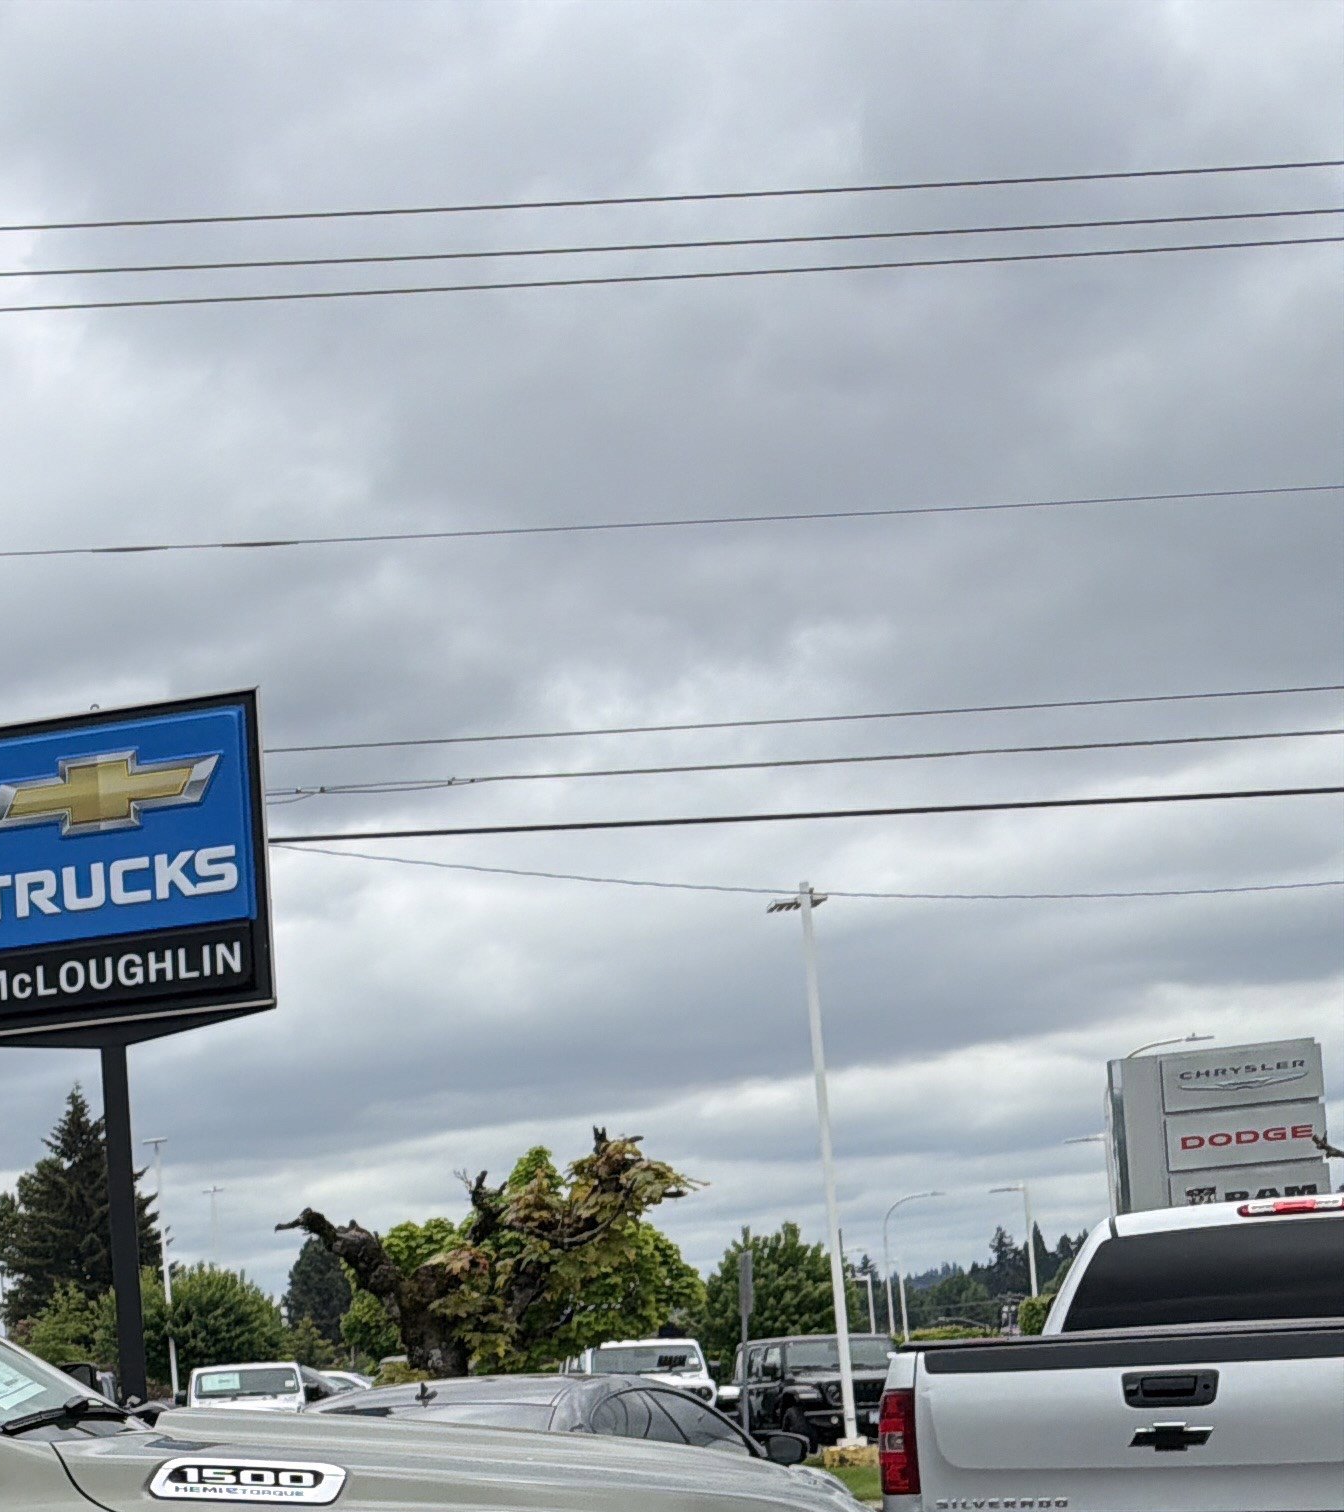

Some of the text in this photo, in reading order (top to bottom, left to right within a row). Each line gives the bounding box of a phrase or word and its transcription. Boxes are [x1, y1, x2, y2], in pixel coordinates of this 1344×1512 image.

[1179, 1059, 1305, 1081] CHRYSLER
[1180, 1124, 1313, 1151] DODGE
[182, 1466, 315, 1488] 1500
[174, 1485, 223, 1494] HEMI
[935, 1497, 1069, 1510] SILVERADO
